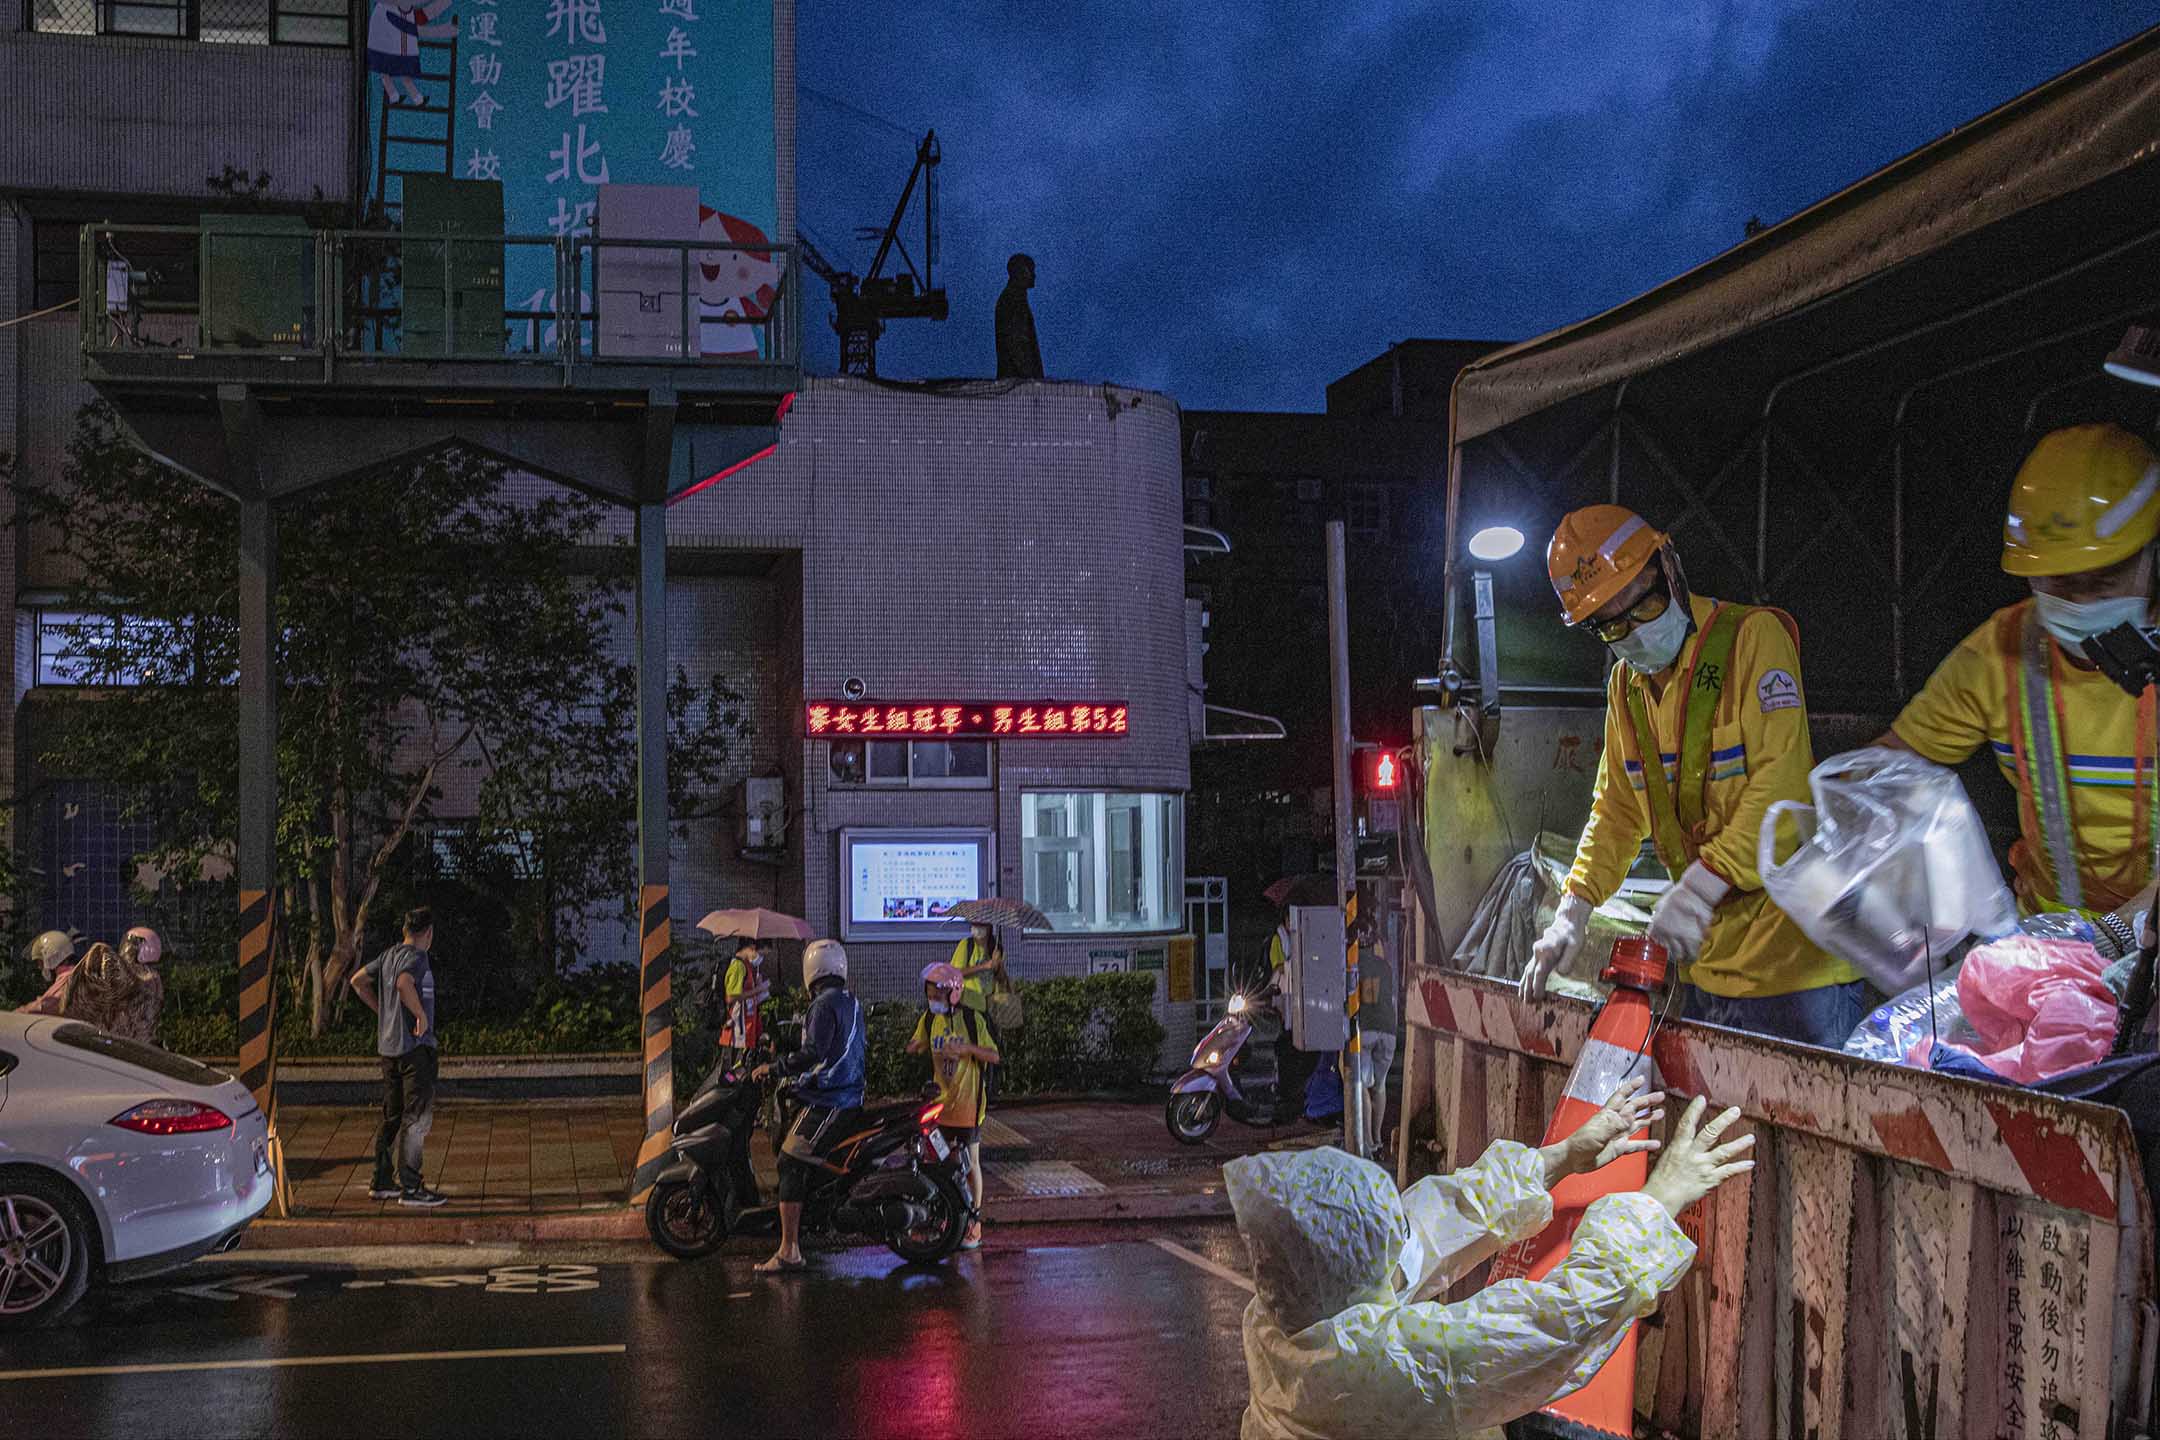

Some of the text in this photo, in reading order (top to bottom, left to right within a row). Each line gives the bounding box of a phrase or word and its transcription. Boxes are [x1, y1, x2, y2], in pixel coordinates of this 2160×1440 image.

[468, 0, 504, 129] 運動會
[1696, 662, 1721, 691] 保
[2003, 1215, 2027, 1429] 以維民眾安全
